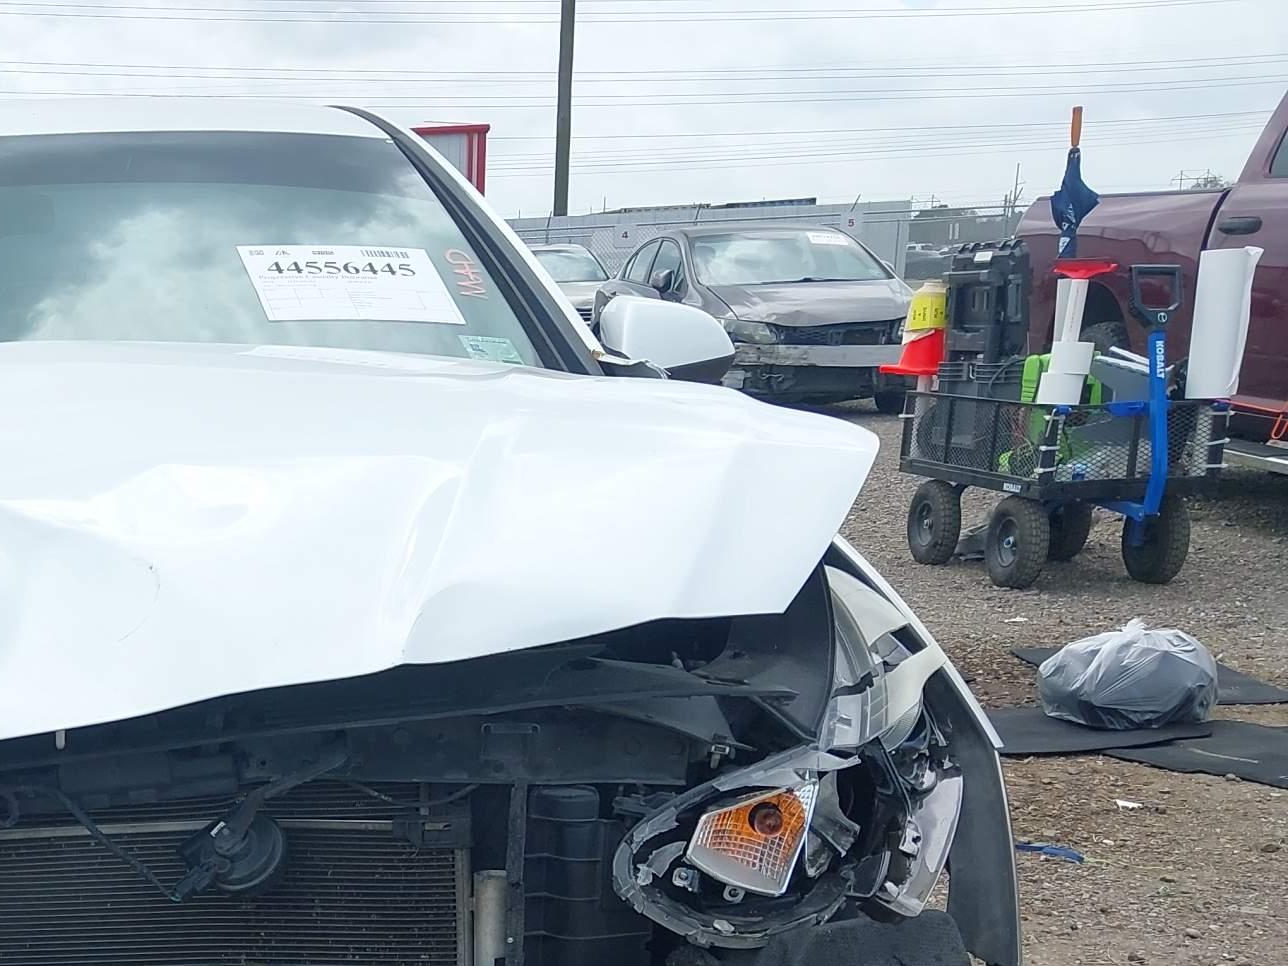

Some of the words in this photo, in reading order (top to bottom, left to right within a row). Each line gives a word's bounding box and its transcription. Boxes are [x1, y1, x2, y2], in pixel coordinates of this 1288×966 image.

[848, 219, 855, 228] 5
[621, 231, 629, 239] 4
[267, 261, 416, 278] 44556445
[1155, 340, 1166, 379] KOBALT
